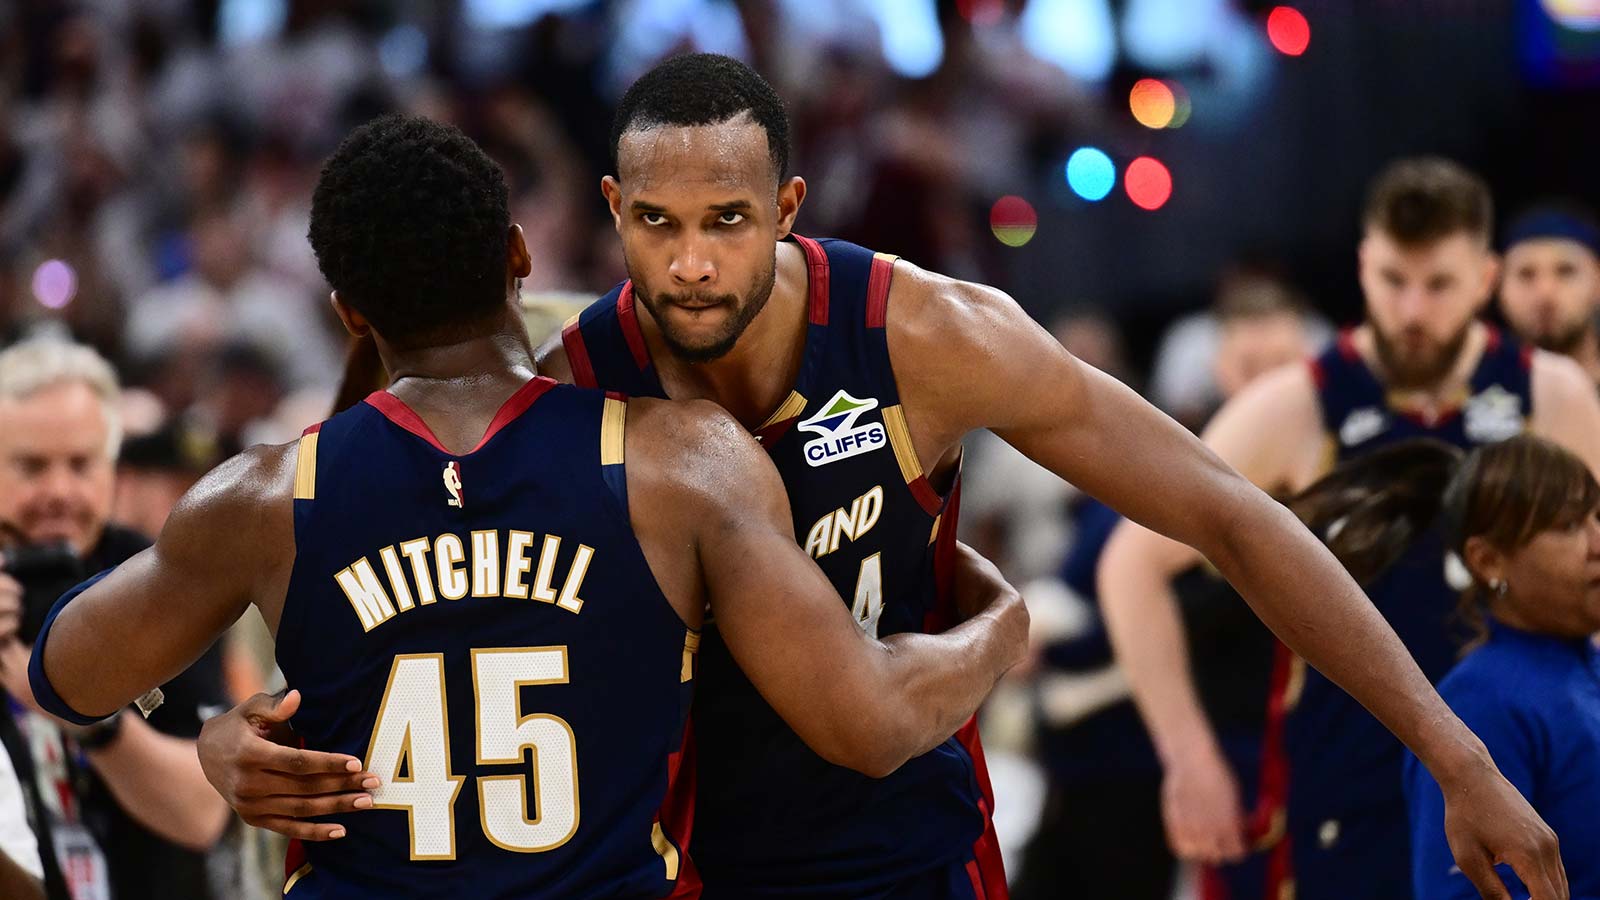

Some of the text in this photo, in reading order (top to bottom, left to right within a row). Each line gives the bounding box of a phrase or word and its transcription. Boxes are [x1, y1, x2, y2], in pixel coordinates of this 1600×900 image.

[807, 427, 884, 461] CLIFFS
[804, 485, 884, 559] AND
[334, 529, 595, 633] MITCHELL
[362, 645, 580, 861] 45
